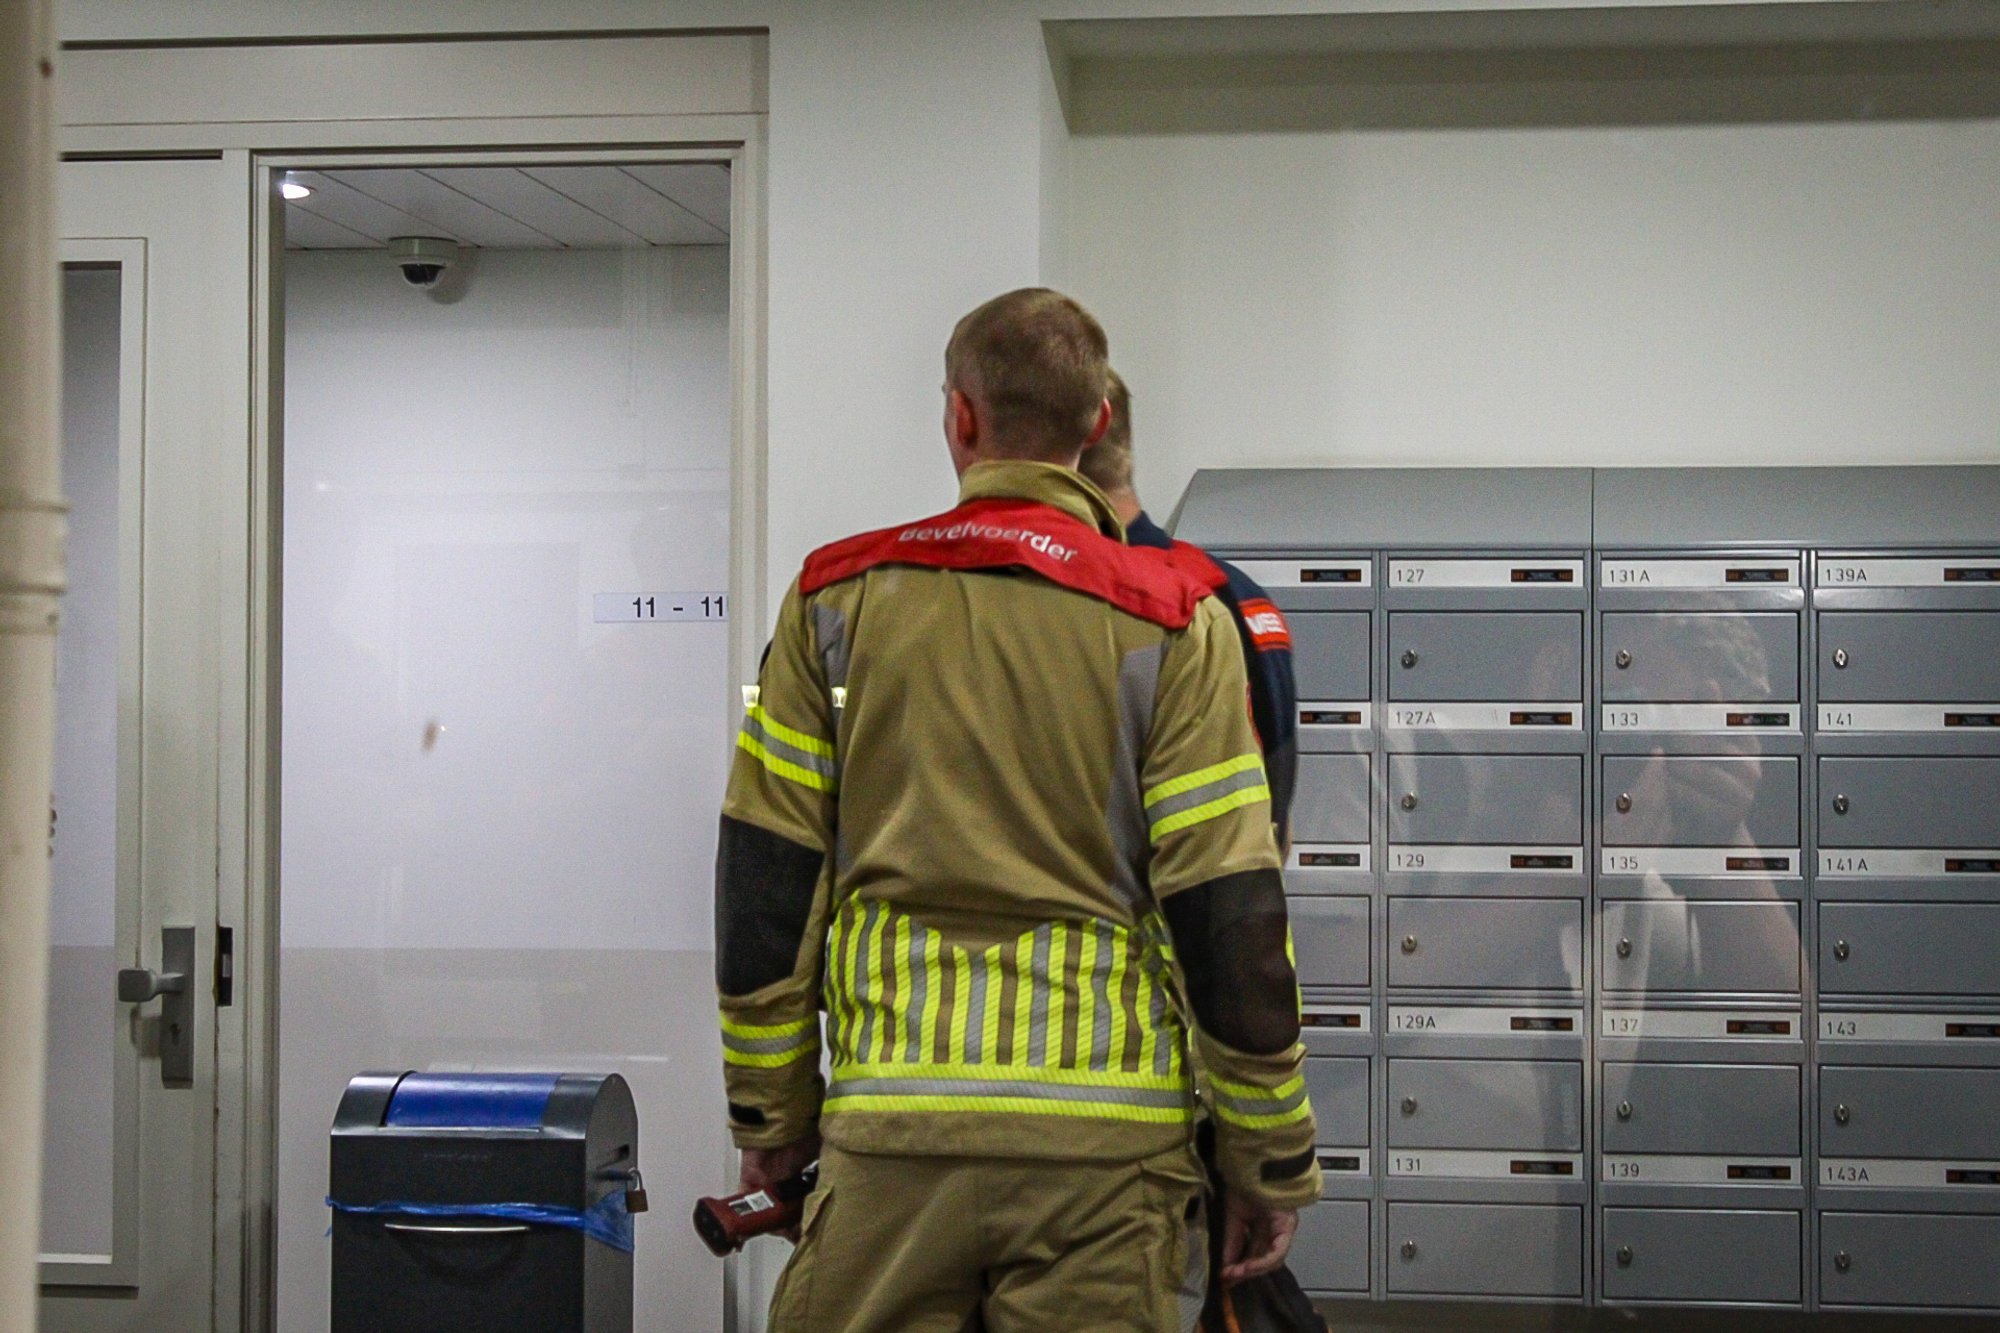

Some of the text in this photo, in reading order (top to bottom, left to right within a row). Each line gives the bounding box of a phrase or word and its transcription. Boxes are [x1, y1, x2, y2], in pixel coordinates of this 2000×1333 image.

[1397, 568, 1425, 584] 127
[1610, 569, 1650, 583] 131A
[1826, 568, 1867, 582] 139A
[632, 596, 655, 618] 11
[701, 595, 729, 617] 11
[1396, 710, 1436, 726] 127A
[1610, 712, 1639, 727] 133
[1826, 712, 1852, 726] 141
[1397, 853, 1425, 868] 129
[1610, 855, 1639, 870] 135
[1827, 857, 1868, 872] 141A
[1395, 1014, 1436, 1030] 129A
[1610, 1017, 1639, 1032] 137
[1827, 1021, 1857, 1036] 143
[1395, 1157, 1421, 1172] 131
[1611, 1162, 1640, 1178] 139
[1826, 1166, 1870, 1182] 143A
